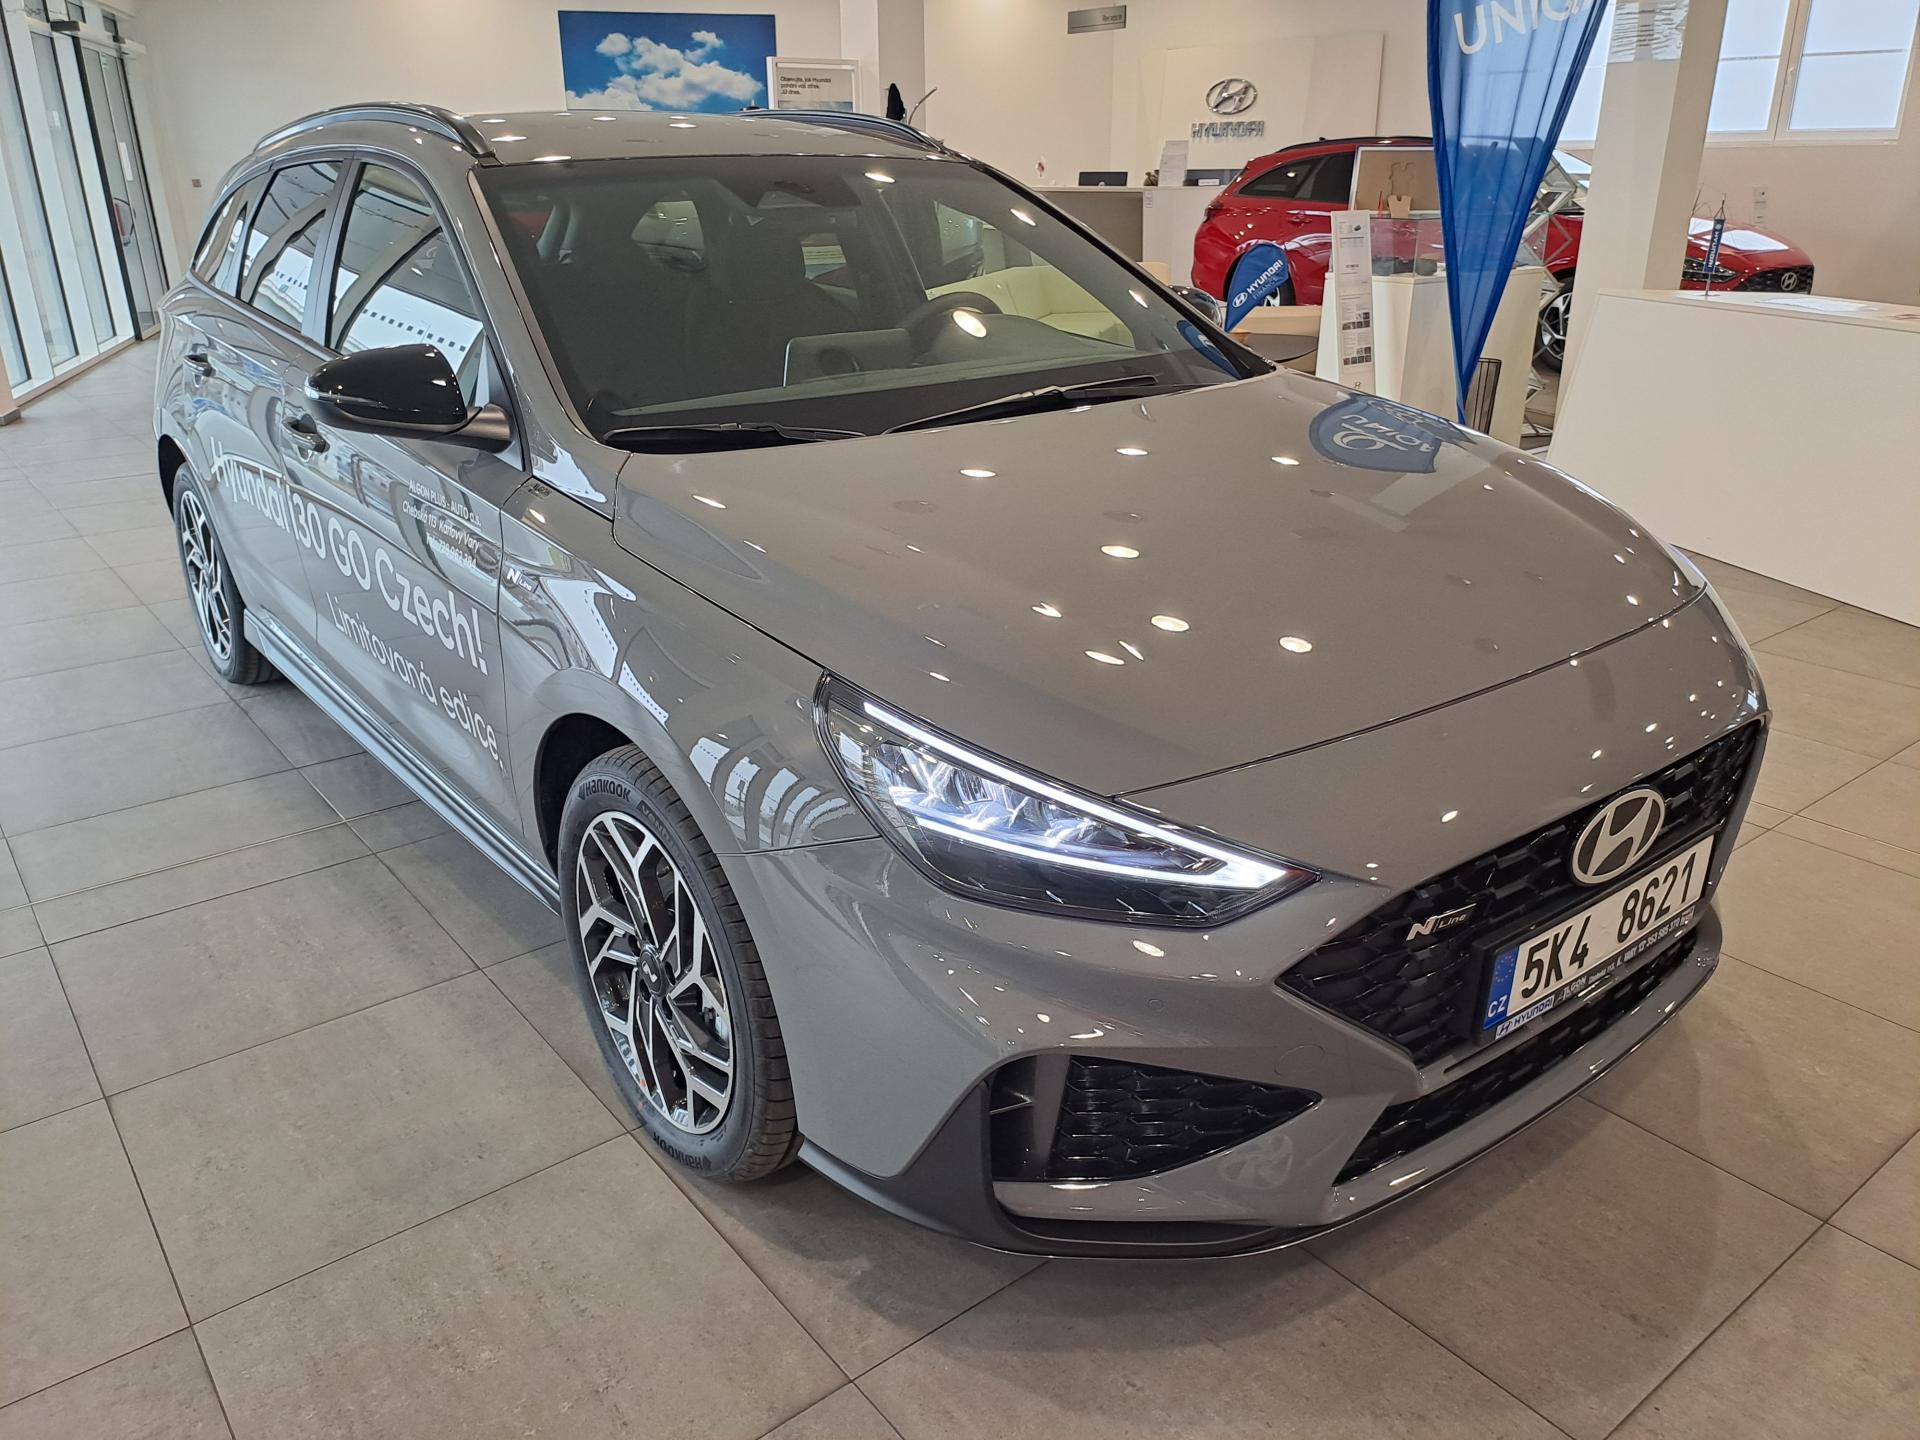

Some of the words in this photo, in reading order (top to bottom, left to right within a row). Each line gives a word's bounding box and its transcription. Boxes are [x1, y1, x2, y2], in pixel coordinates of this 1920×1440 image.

[1191, 120, 1265, 139] HYUNDAI
[1708, 231, 1720, 268] HYUNDAI
[1246, 259, 1284, 294] HYUNDAI
[408, 479, 430, 500] ALGON
[430, 490, 447, 508] PLUS
[450, 501, 469, 520] AUTO
[428, 514, 437, 528] 113
[438, 519, 464, 544] Karlovy
[463, 532, 480, 553] Vary
[211, 436, 290, 534] Hyundai
[284, 483, 327, 560] i30
[328, 517, 371, 591] GO
[374, 547, 489, 677] Czech!
[326, 591, 438, 706] Limitovaná
[439, 686, 505, 769] edice.
[1521, 914, 1592, 999] 5K4
[1616, 851, 1697, 944] 8621
[1487, 994, 1508, 1018] CZ
[1513, 998, 1553, 1027] HYUNDAI
